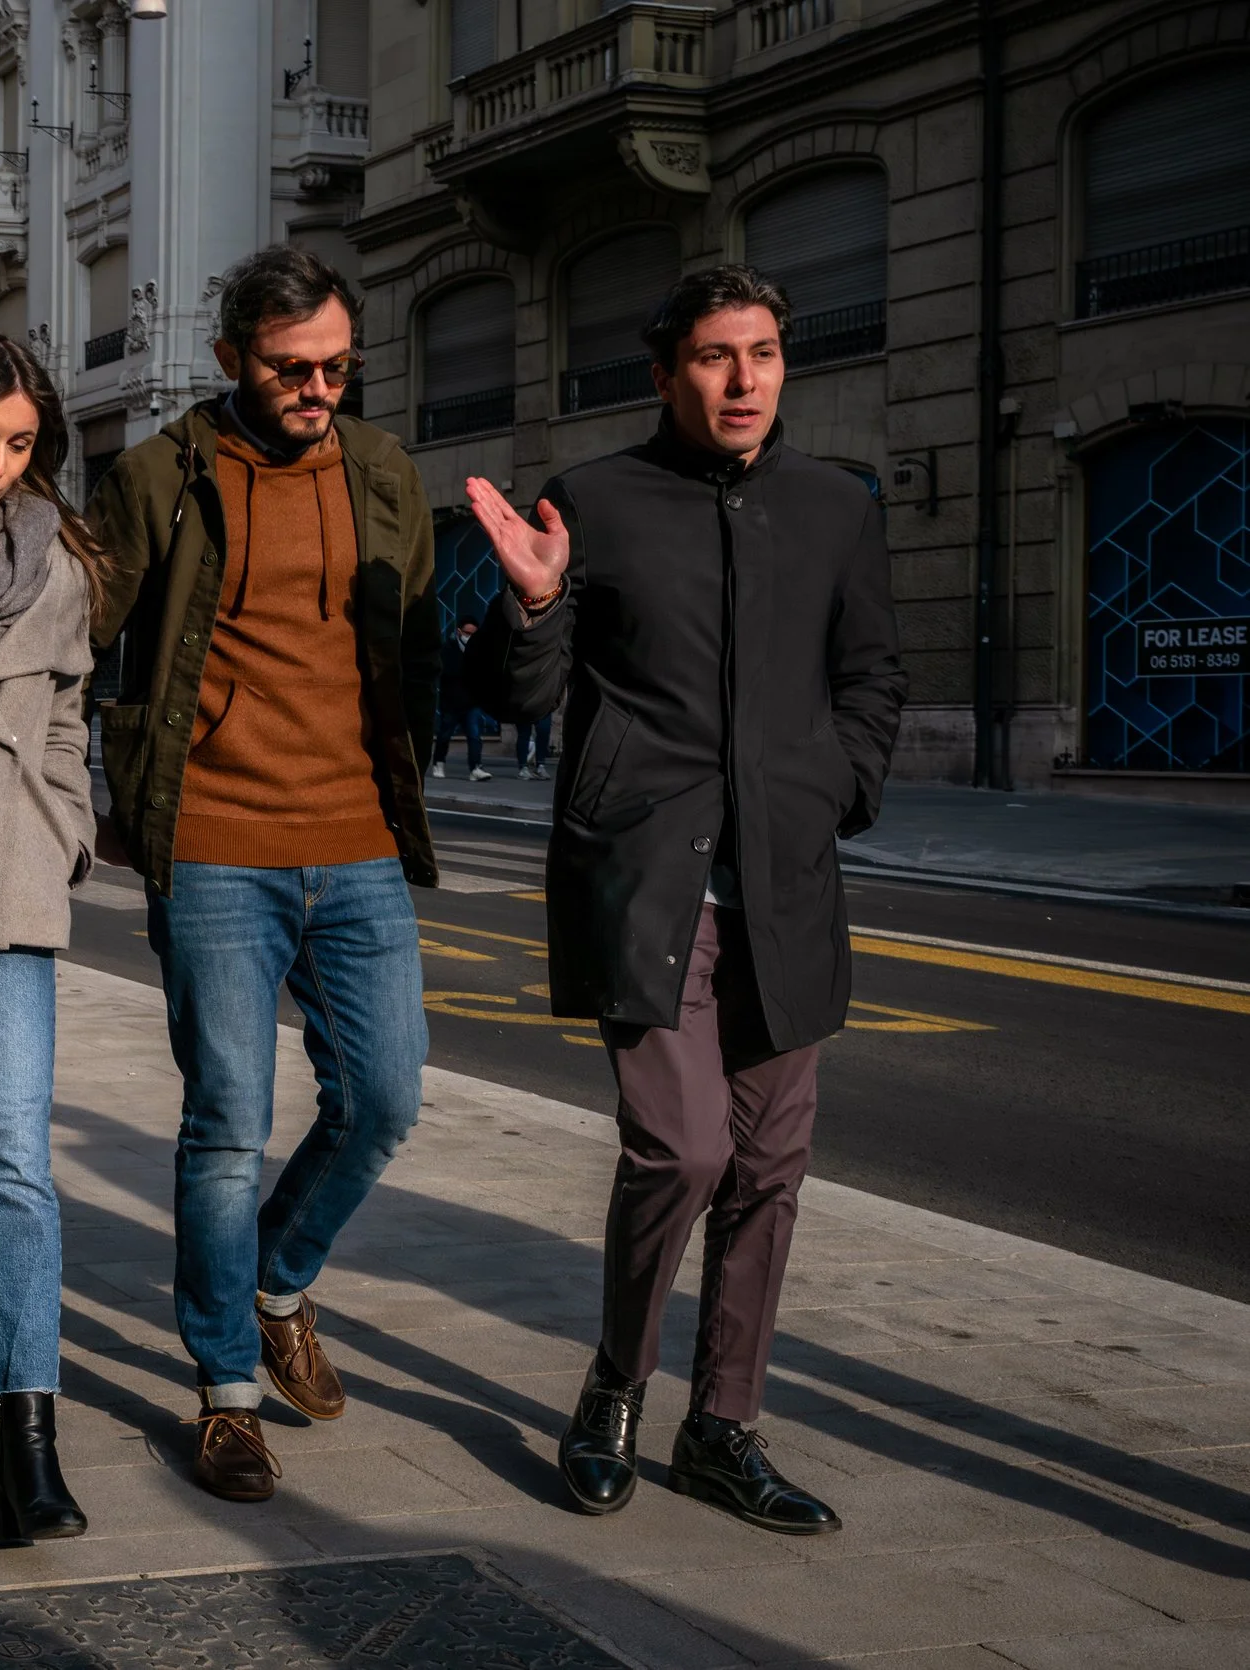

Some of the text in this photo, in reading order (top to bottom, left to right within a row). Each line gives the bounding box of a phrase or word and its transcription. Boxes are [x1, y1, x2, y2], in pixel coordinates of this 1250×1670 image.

[1143, 625, 1248, 648] FOR LEASE
[1149, 655, 1168, 669] 06
[1169, 654, 1197, 668] 5131
[1206, 652, 1241, 668] 8349
